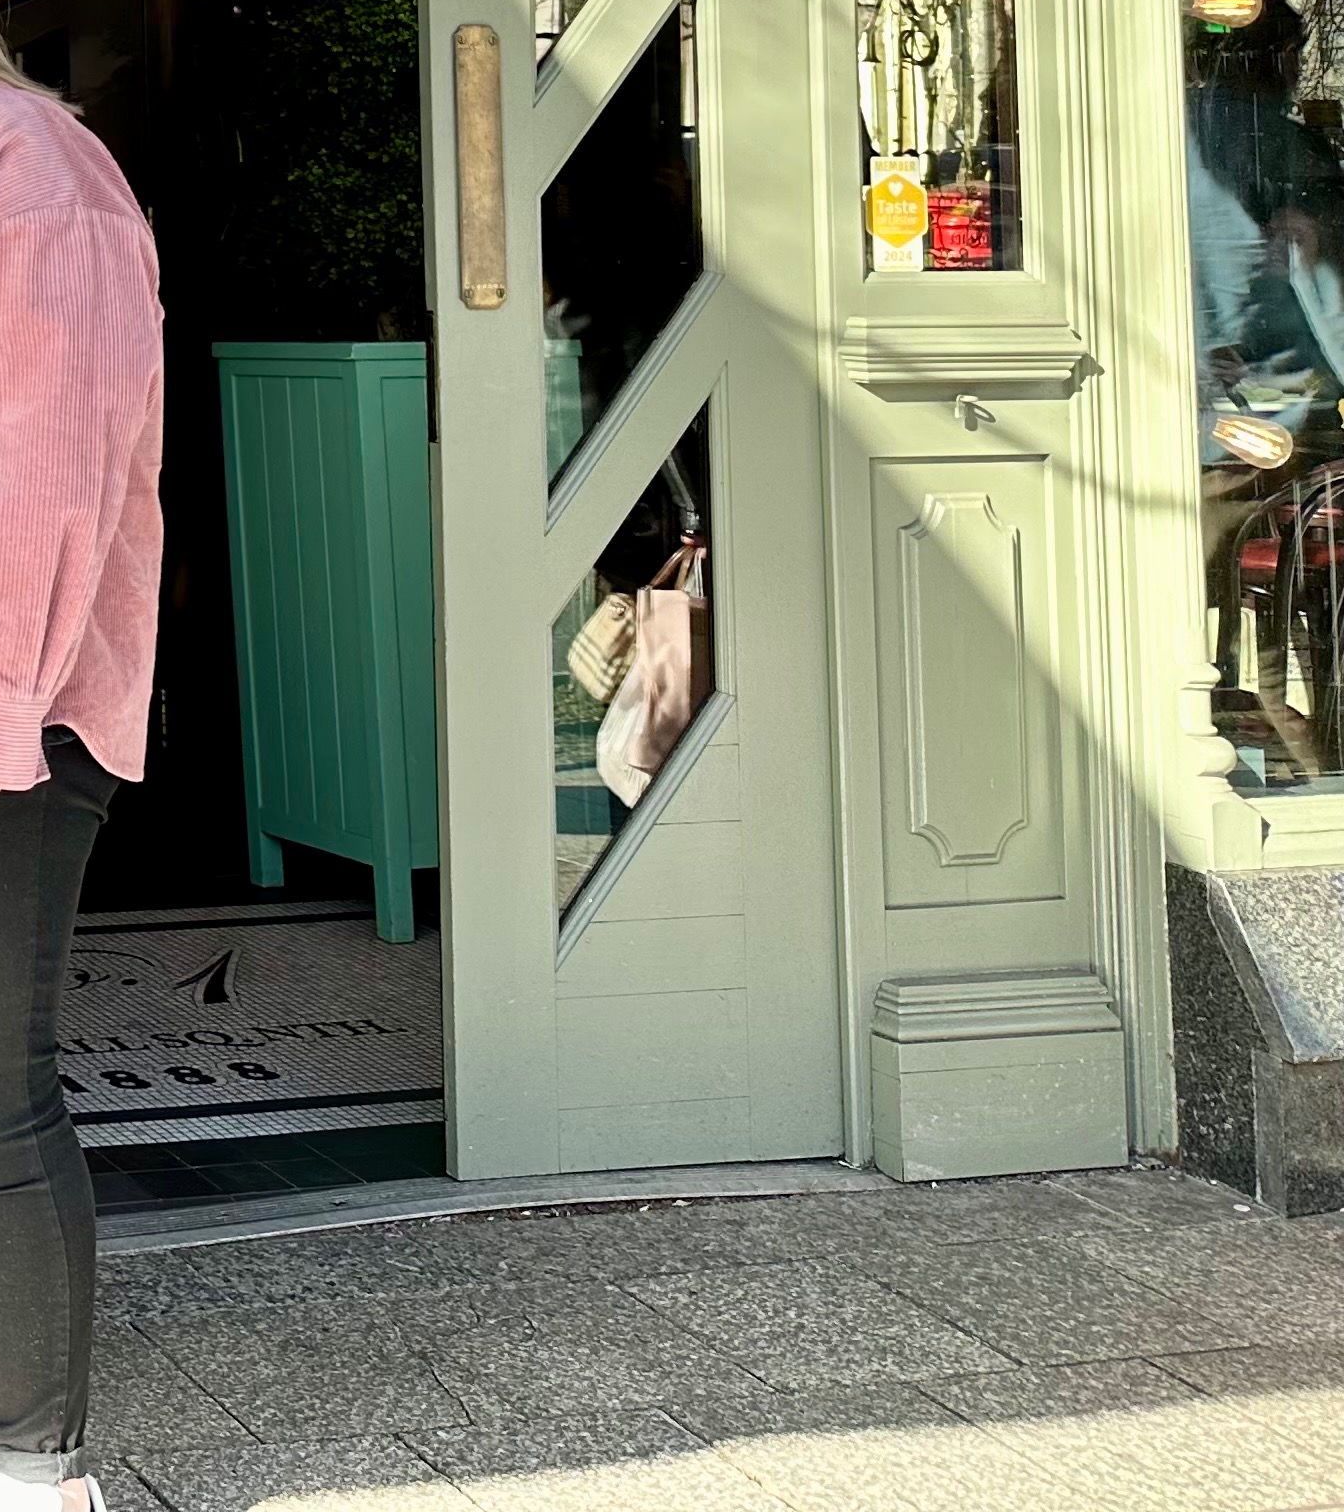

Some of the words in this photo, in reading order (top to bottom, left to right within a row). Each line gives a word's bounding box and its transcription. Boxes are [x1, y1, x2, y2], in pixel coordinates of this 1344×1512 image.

[875, 161, 916, 172] MEMBER
[877, 199, 918, 214] Taste
[884, 251, 912, 262] 2024
